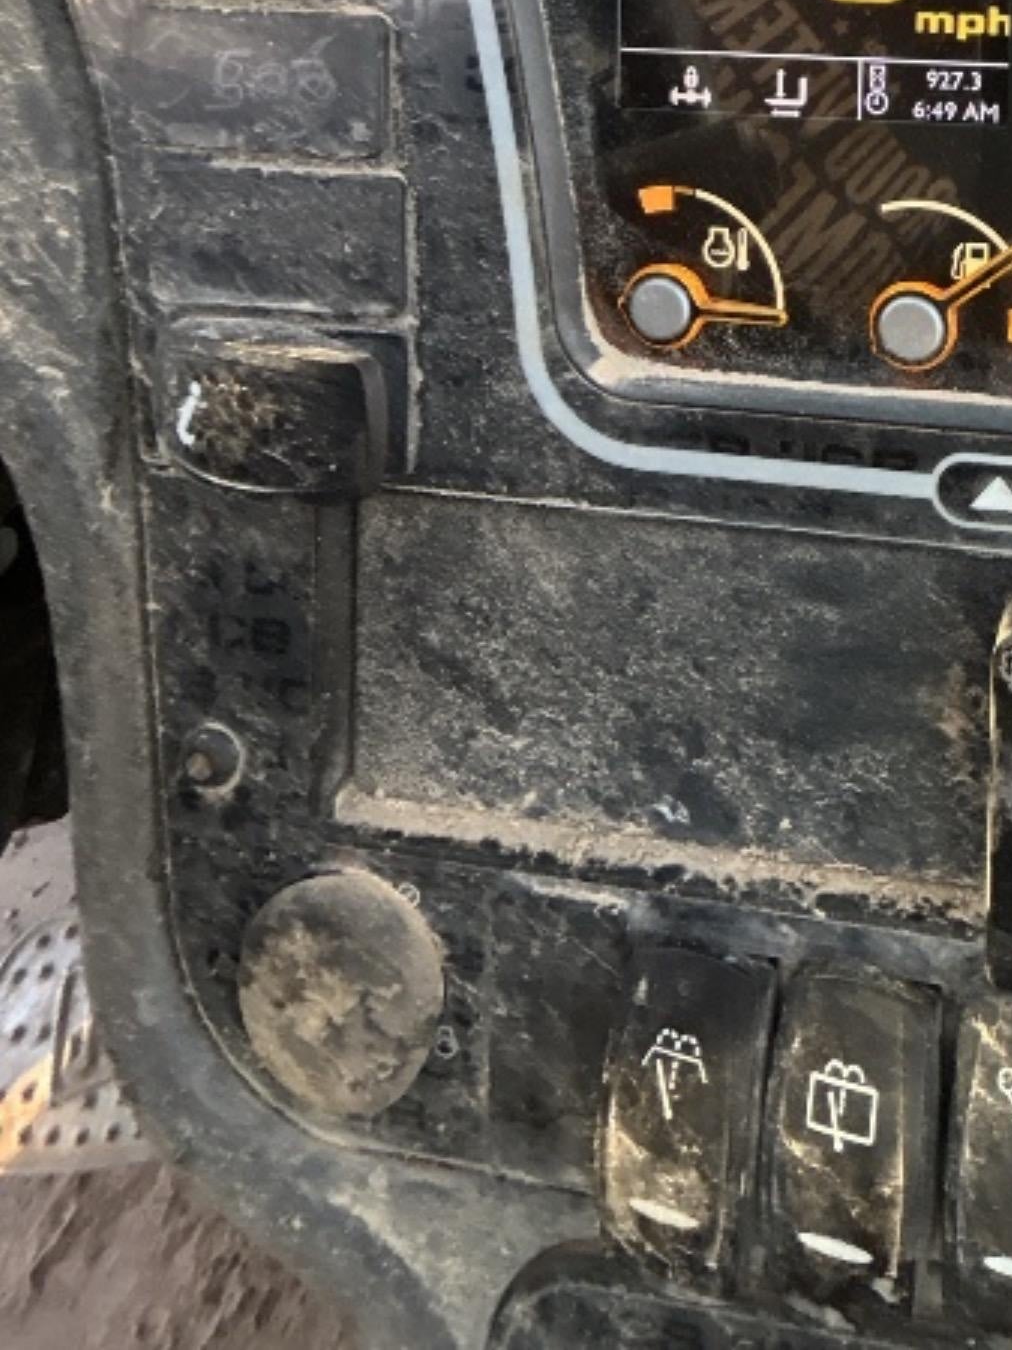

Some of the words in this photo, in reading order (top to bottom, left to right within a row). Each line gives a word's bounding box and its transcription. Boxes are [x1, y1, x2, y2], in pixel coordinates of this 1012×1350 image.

[914, 5, 1012, 41] mph
[925, 70, 983, 92] 927.3
[912, 100, 959, 122] 6:49
[962, 101, 1001, 124] AM
